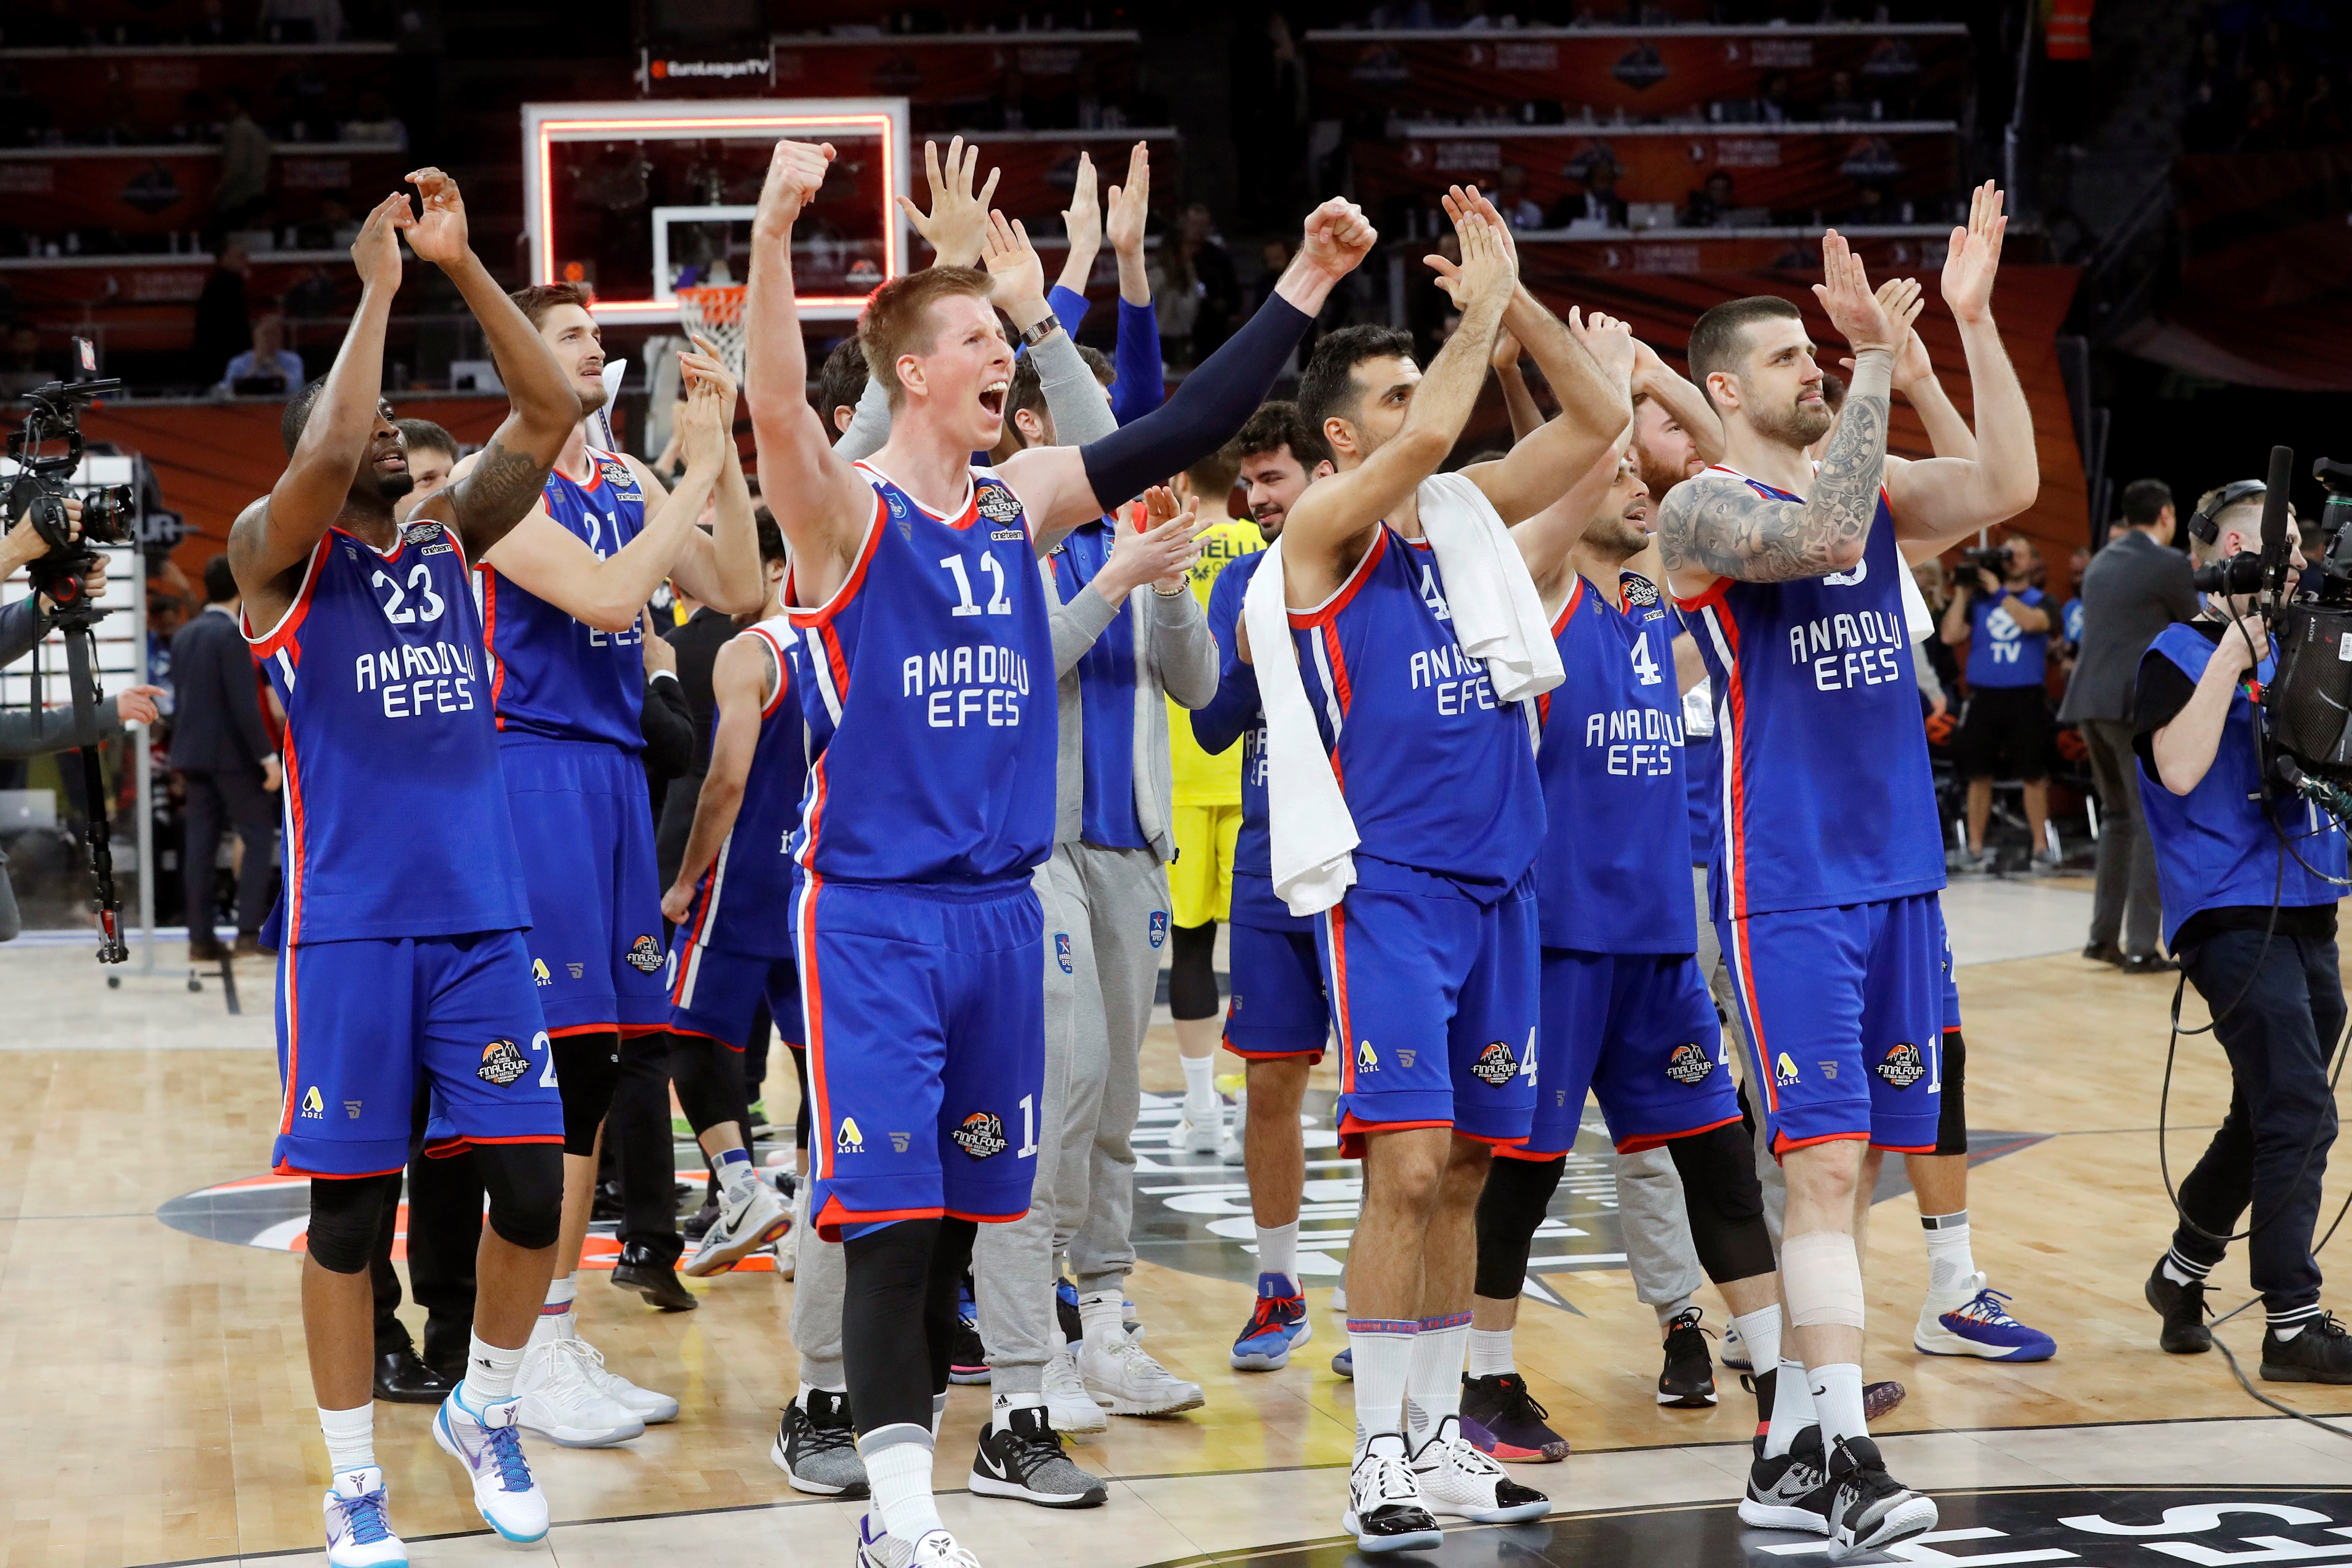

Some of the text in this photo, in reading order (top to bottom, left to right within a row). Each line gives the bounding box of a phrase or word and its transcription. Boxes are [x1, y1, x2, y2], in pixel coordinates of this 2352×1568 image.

[423, 544, 452, 554] oneteam
[584, 511, 623, 562] 21
[992, 530, 1023, 539] oneteam
[371, 564, 445, 624] 23
[940, 550, 1012, 616] 12
[1419, 564, 1452, 621] 4
[1790, 611, 1902, 665] ANADOLU
[1991, 643, 2020, 662] TV
[356, 642, 475, 693] ANADOLU
[903, 645, 1029, 698] ANADOLU
[1630, 632, 1662, 686] 4
[1814, 647, 1900, 692] EFES
[383, 678, 474, 718] EFES
[928, 689, 1020, 728] EFES
[1437, 676, 1507, 716] EFE
[625, 953, 665, 963] FINALFOUR
[476, 1060, 532, 1078] FINALFOUR
[532, 1031, 559, 1088] 2
[1358, 1063, 1380, 1074] ADEL
[1470, 1062, 1519, 1074] FINALFOUR
[1520, 1026, 1537, 1087] 4
[1665, 1061, 1715, 1076] FINALFOUR
[1875, 1064, 1926, 1075] FINALFOUR
[1927, 1033, 1943, 1094] 1
[1776, 1077, 1801, 1087] ADEL
[301, 1111, 323, 1119] ADEL
[1017, 1093, 1042, 1159] 1
[837, 1145, 865, 1154] ADEL
[951, 1130, 1009, 1149] FINALFOUR
[1266, 1281, 1274, 1298] 1
